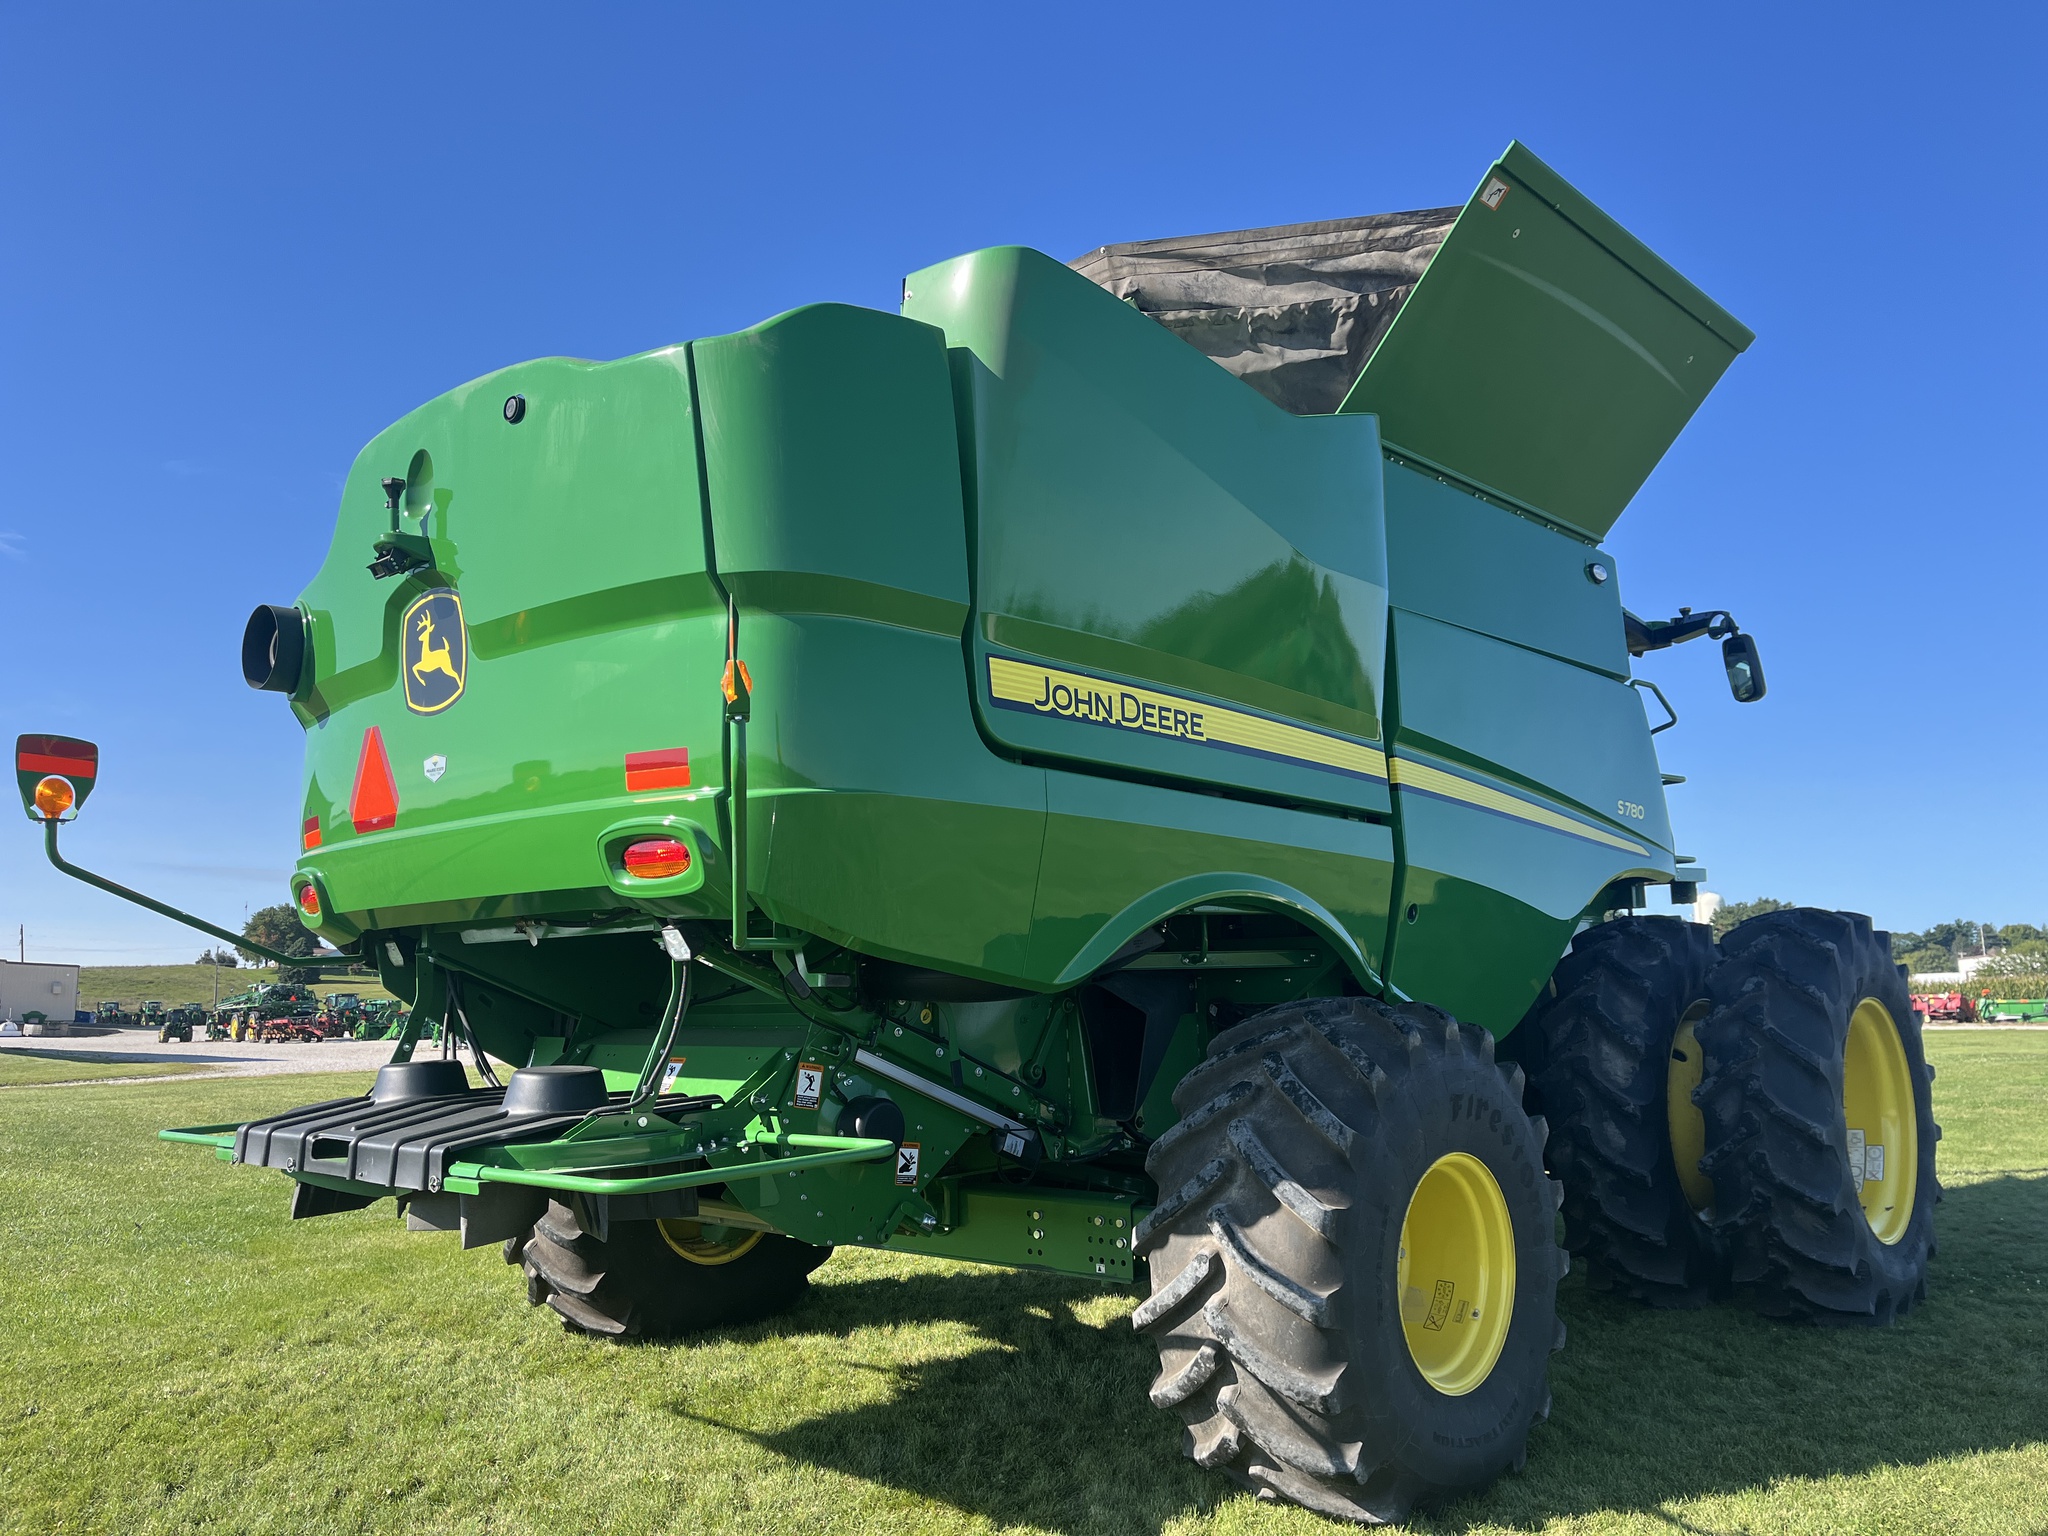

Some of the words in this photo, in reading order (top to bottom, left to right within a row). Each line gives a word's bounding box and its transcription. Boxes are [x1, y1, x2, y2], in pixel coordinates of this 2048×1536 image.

[1034, 676, 1114, 721] JOHN
[1120, 692, 1205, 739] DEERE
[1617, 799, 1645, 820] S780
